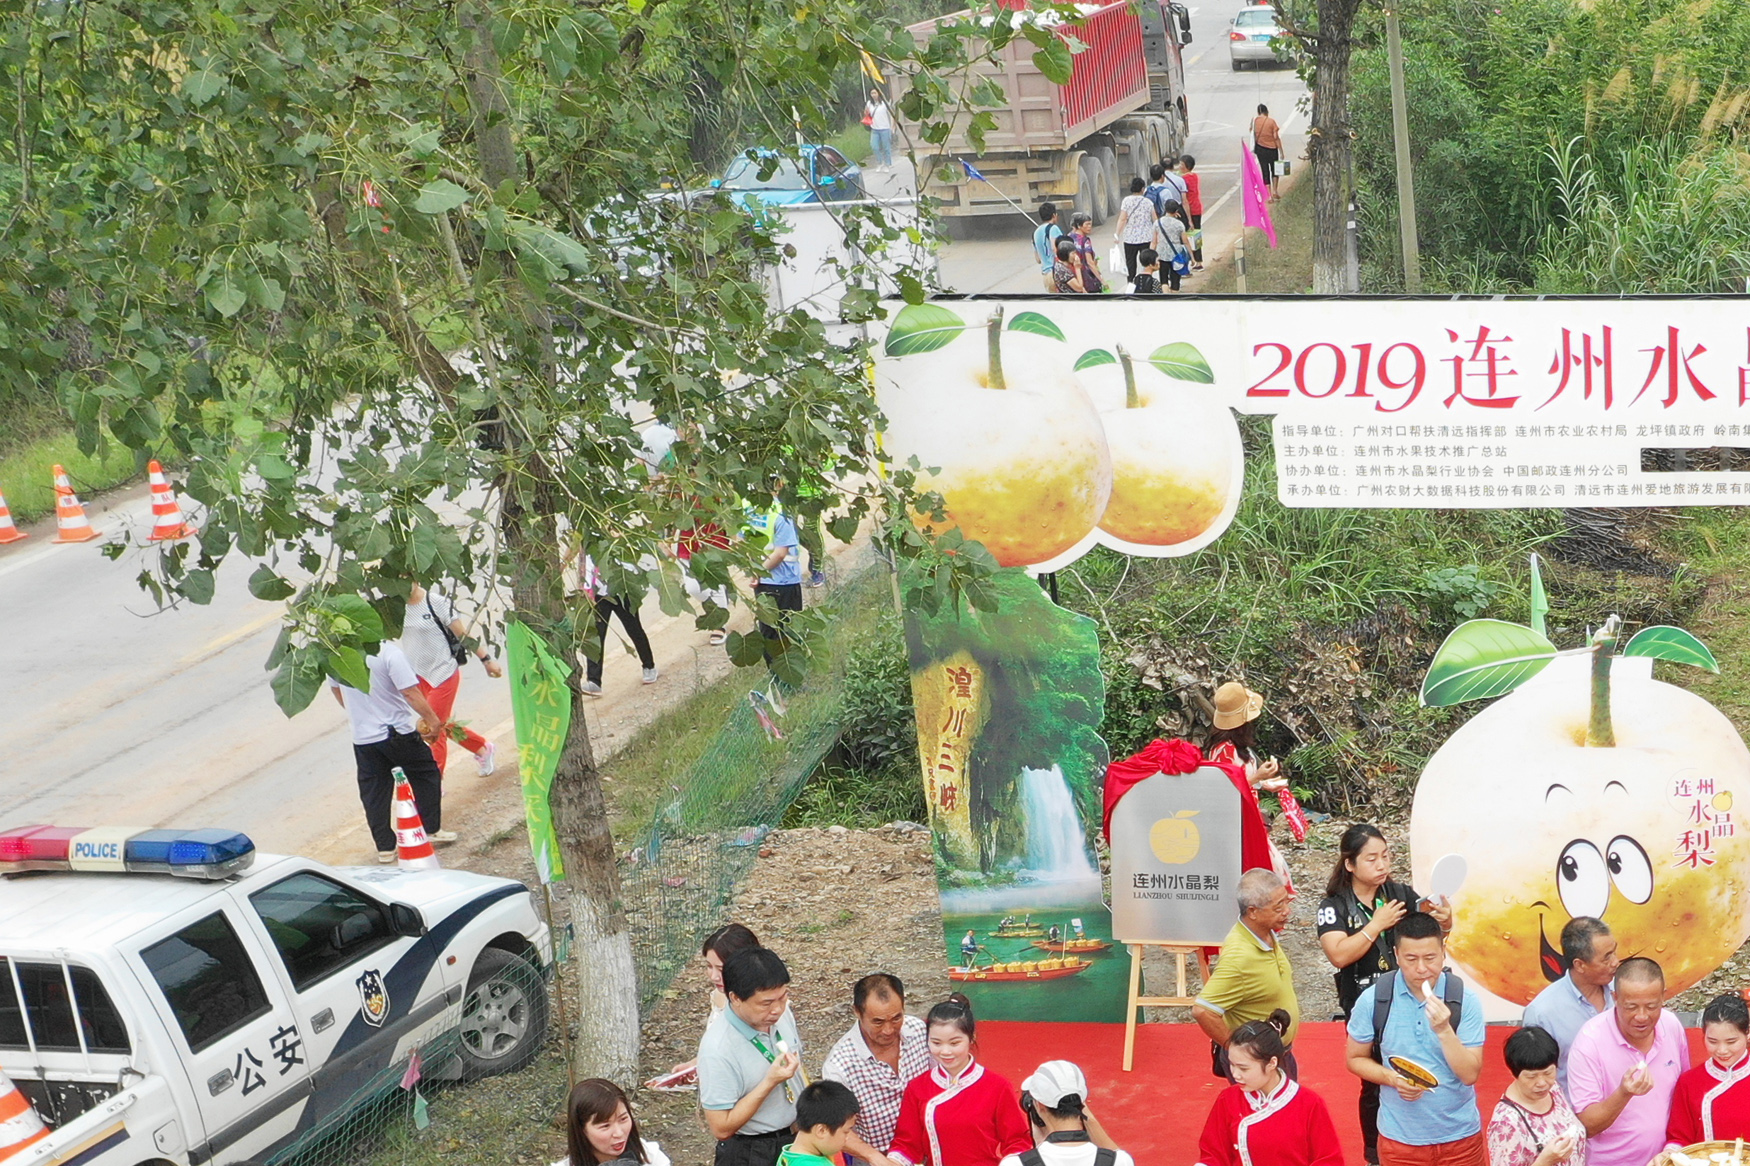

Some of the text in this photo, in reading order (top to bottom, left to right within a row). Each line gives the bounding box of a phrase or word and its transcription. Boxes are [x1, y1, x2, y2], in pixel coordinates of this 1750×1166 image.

[1515, 424, 1628, 438] 连州市农业农村局
[1636, 424, 1705, 437] 龙坪镇政府
[1503, 464, 1628, 477] 中国邮政连州分公司
[1674, 778, 1715, 797] 连州
[75, 842, 118, 858] POLICE
[1671, 829, 1717, 869] 梨
[1133, 873, 1219, 891] 连州水晶梨
[1133, 891, 1173, 900] LIANZHOU
[1317, 906, 1337, 926] 68
[234, 1025, 304, 1097] 公安
